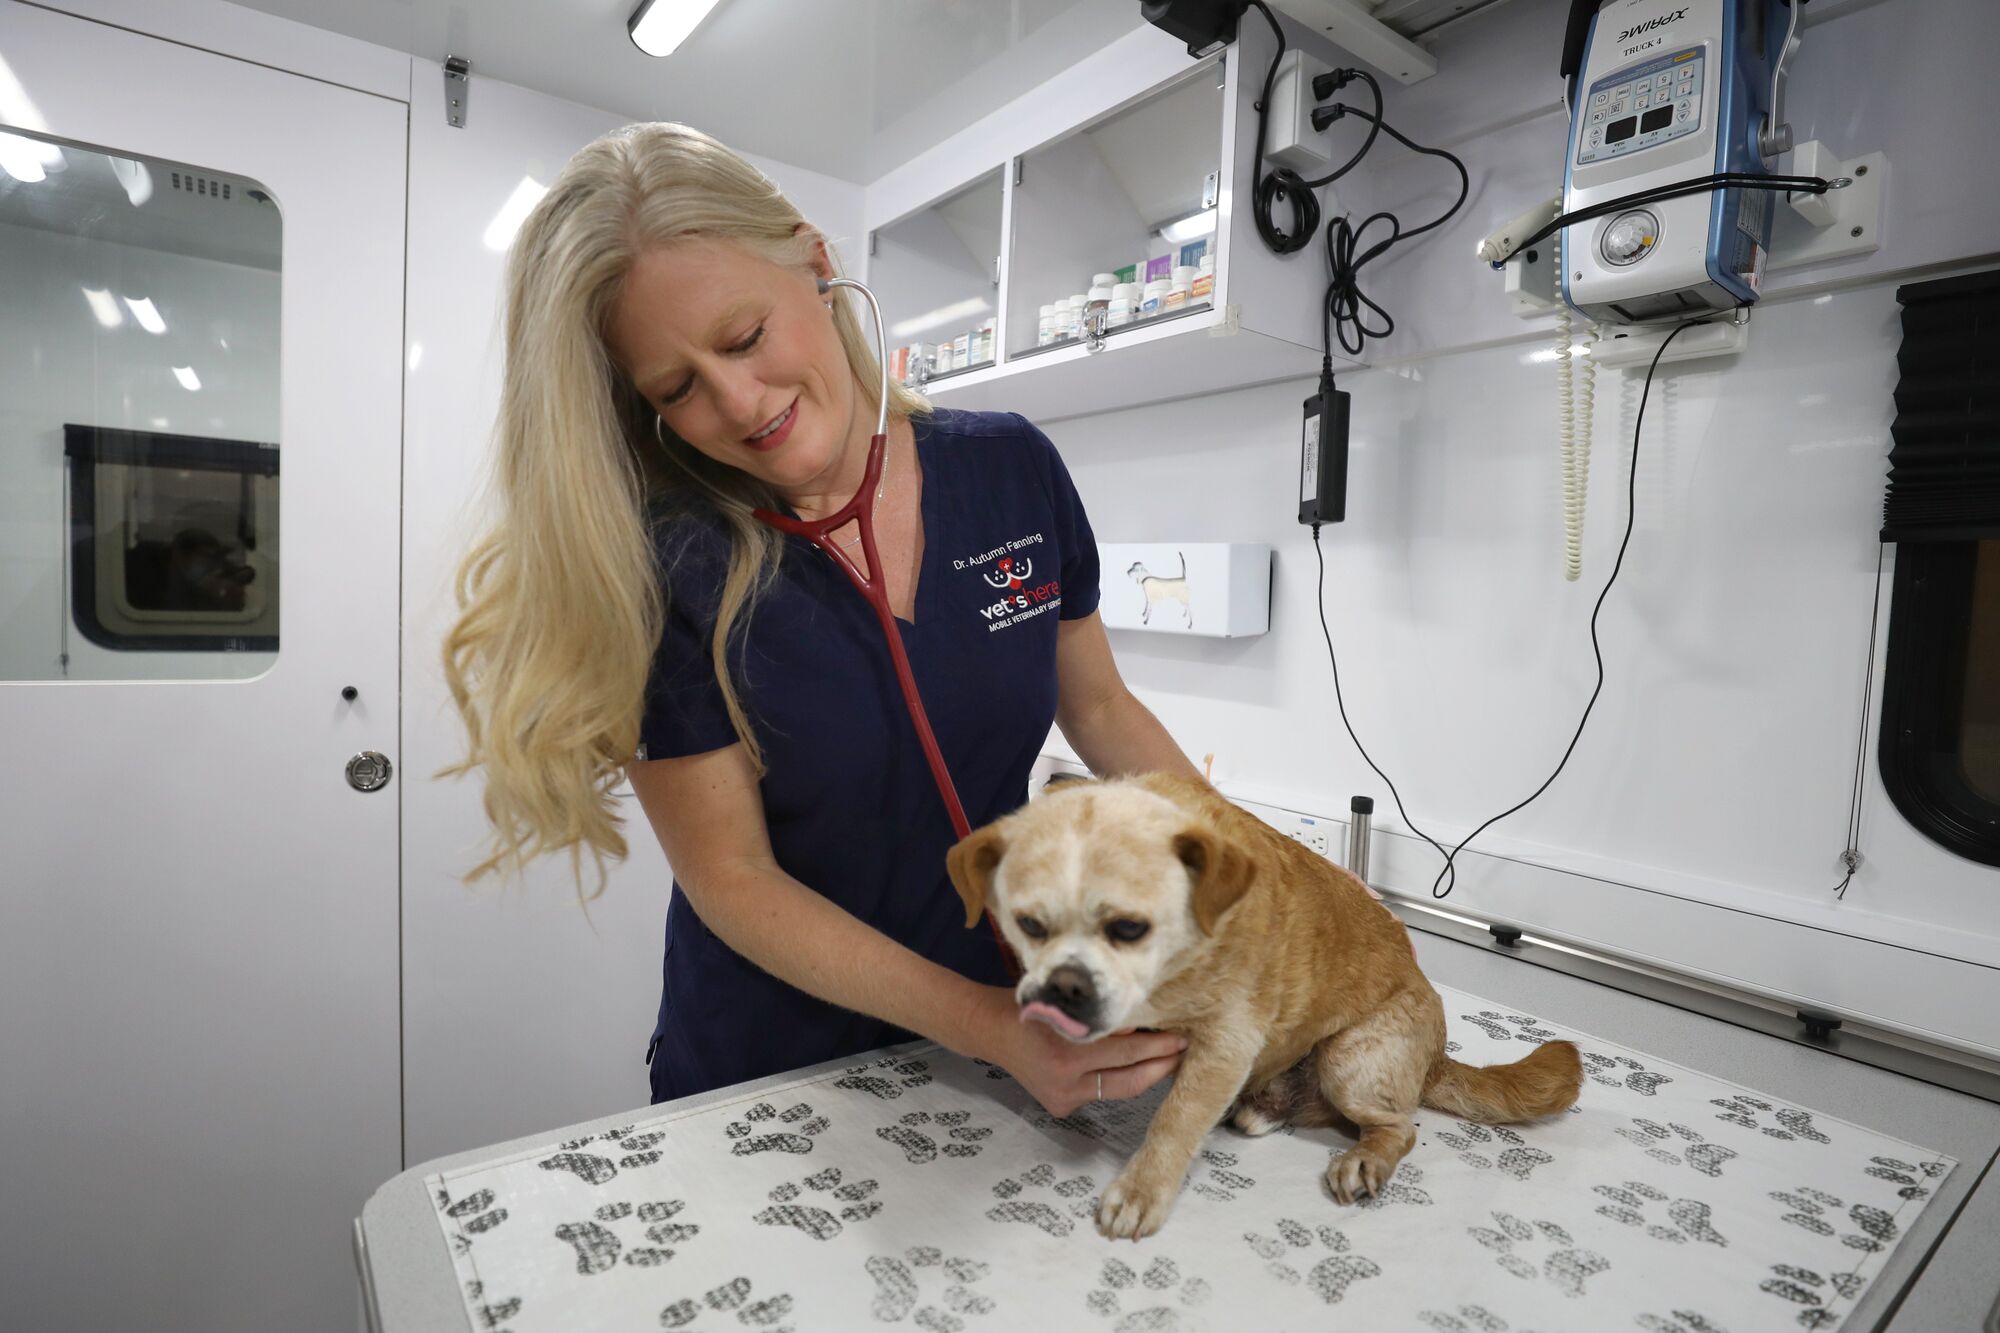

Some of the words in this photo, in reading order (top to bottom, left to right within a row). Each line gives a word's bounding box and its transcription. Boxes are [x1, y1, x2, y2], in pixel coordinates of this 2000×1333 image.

[1617, 7, 1689, 43] XPRIME
[1623, 39, 1655, 57] TRUCK
[1656, 37, 1662, 45] 4
[953, 560, 969, 570] Dr.
[969, 546, 1007, 566] Autumn
[1006, 533, 1043, 552] Fanning
[988, 618, 1012, 633] MOBILE
[1012, 603, 1048, 624] VETERINARY
